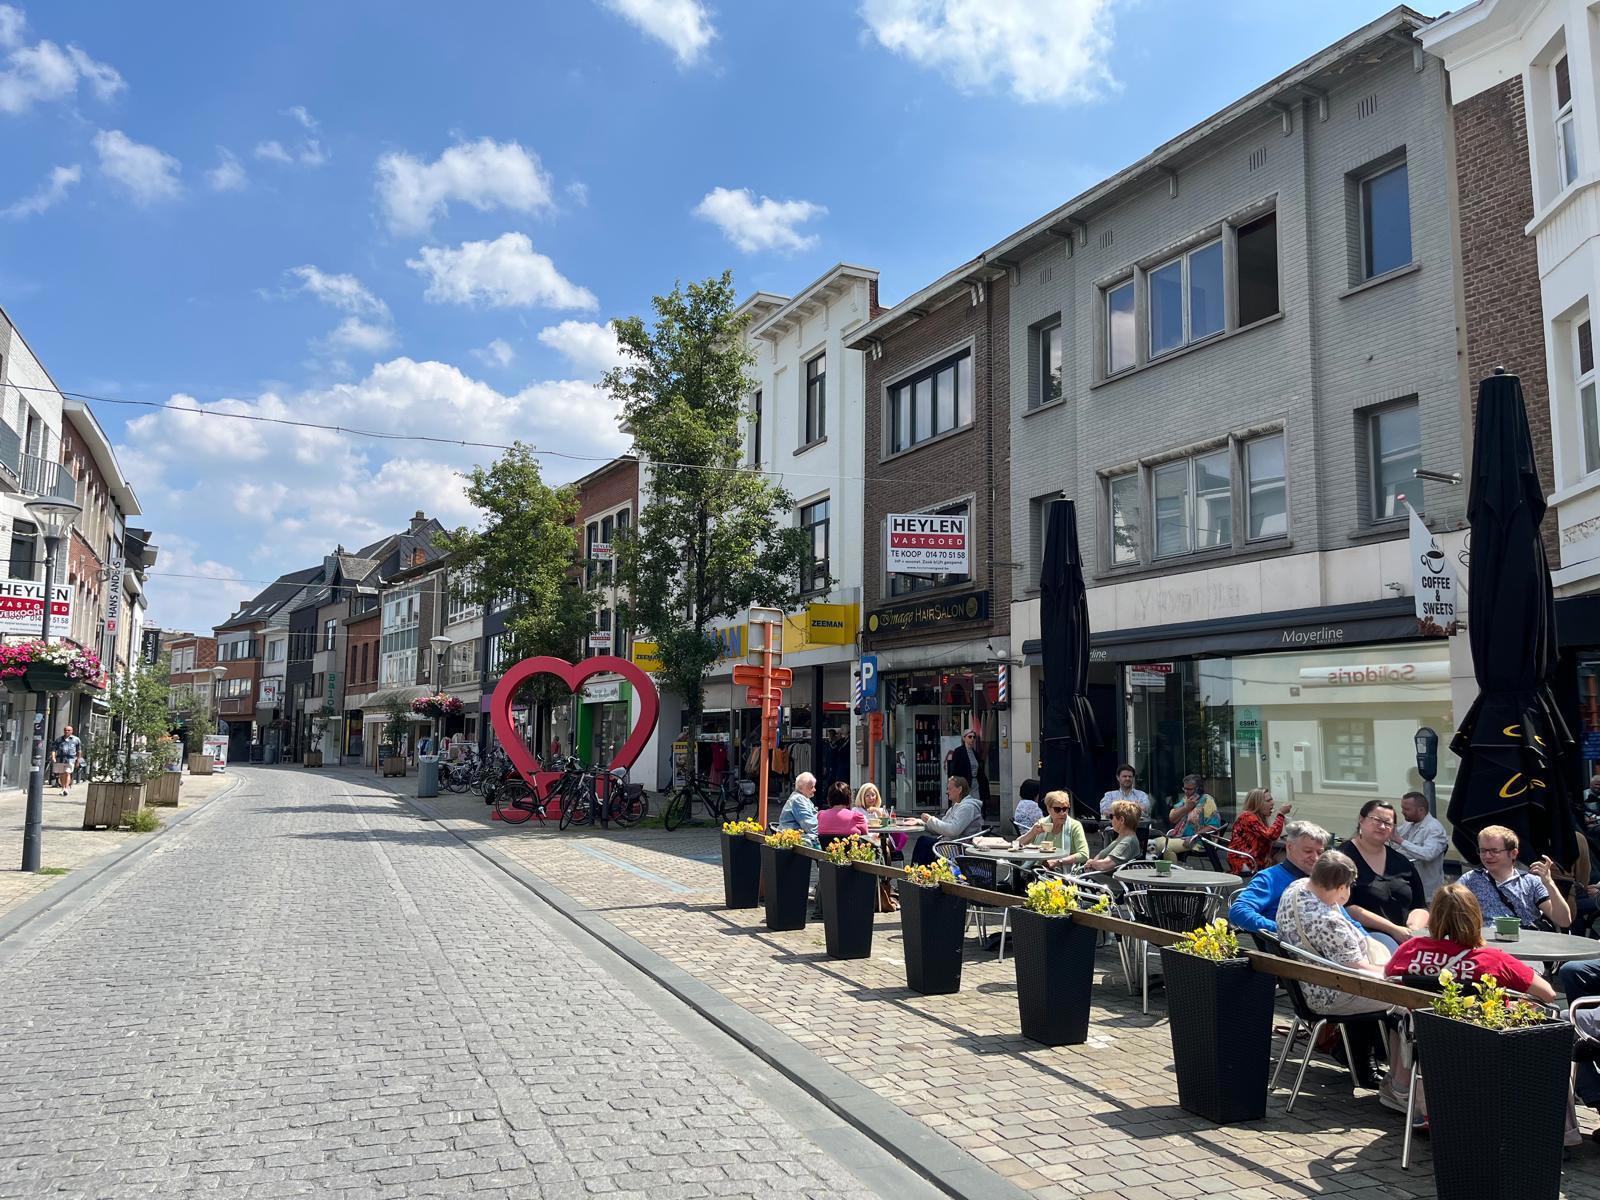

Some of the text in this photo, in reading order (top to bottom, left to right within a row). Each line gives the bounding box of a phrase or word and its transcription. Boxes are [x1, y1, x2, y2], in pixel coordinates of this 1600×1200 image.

[894, 519, 963, 533] HEYLEN
[893, 537, 963, 545] VASTGOED
[901, 550, 922, 558] KOOP
[1422, 576, 1450, 589] COFFEE
[1436, 590, 1440, 601] &
[0, 600, 68, 612] VASTGED
[108, 595, 118, 618] HANS
[1423, 602, 1454, 615] SWEETS
[812, 620, 843, 628] ZEEMAN
[1282, 627, 1342, 644] Mayerline
[862, 662, 874, 690] P
[1408, 962, 1474, 980] ROE
